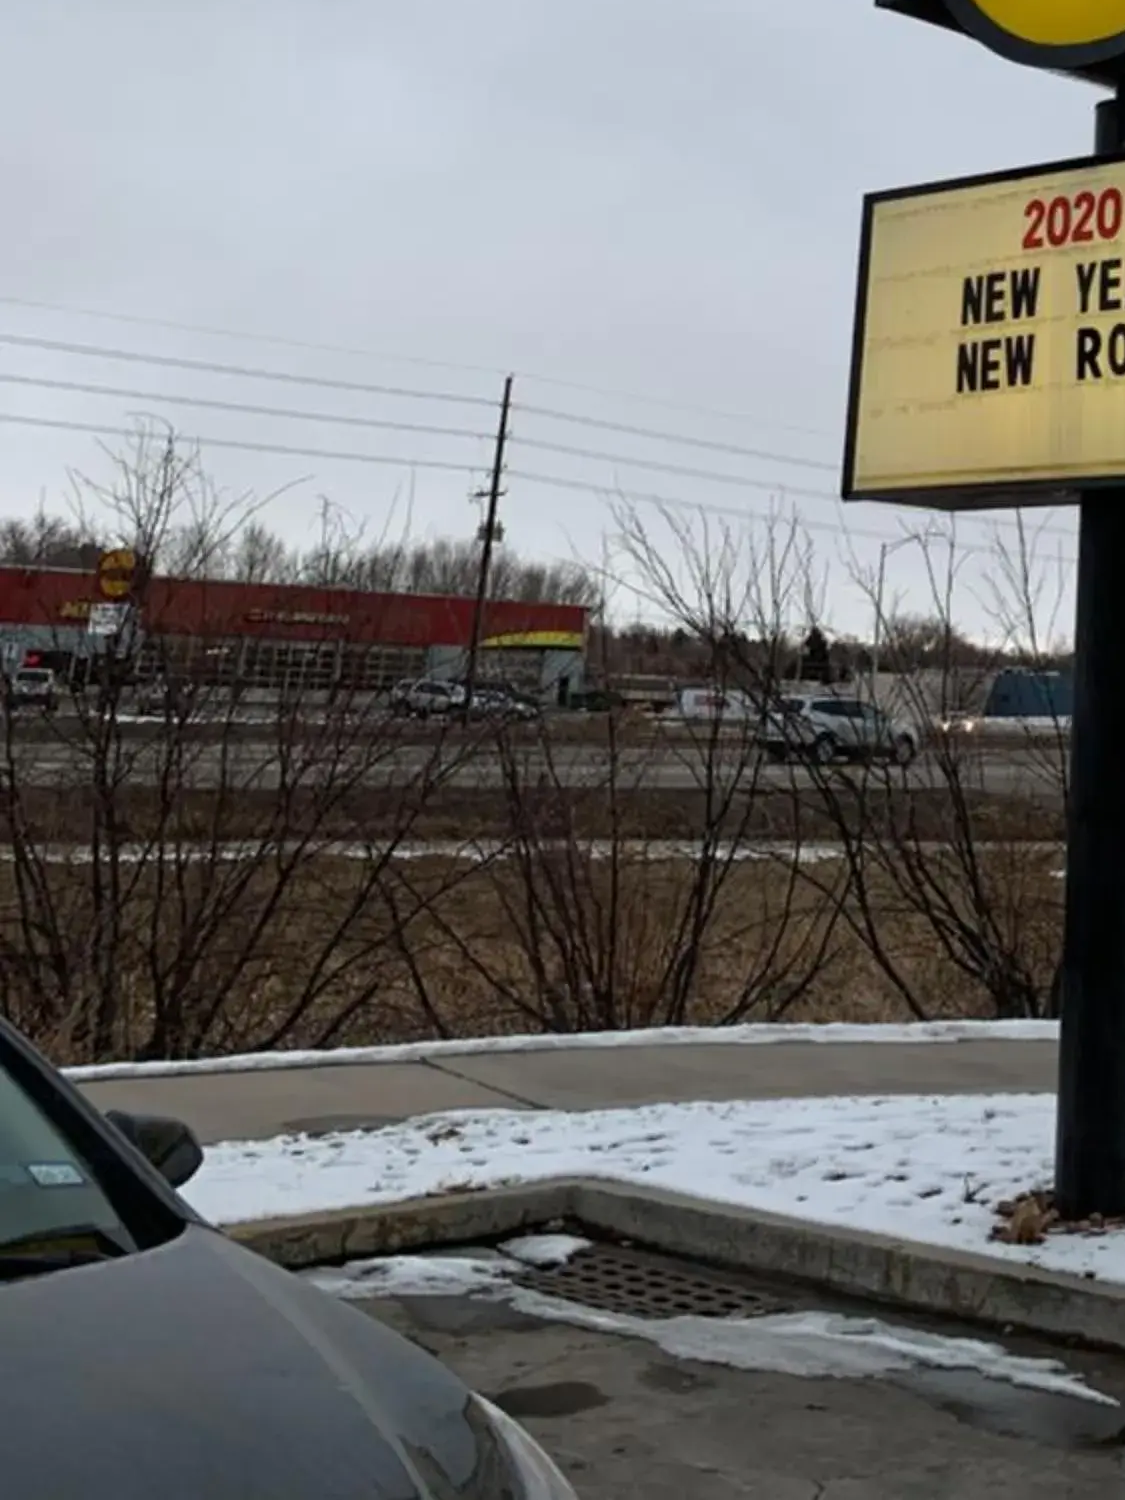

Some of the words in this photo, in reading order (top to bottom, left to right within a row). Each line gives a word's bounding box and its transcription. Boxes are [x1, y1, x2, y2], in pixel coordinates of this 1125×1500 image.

[1021, 187, 1124, 250] 2020
[960, 266, 1041, 326] NEW
[955, 334, 1036, 394] NEW
